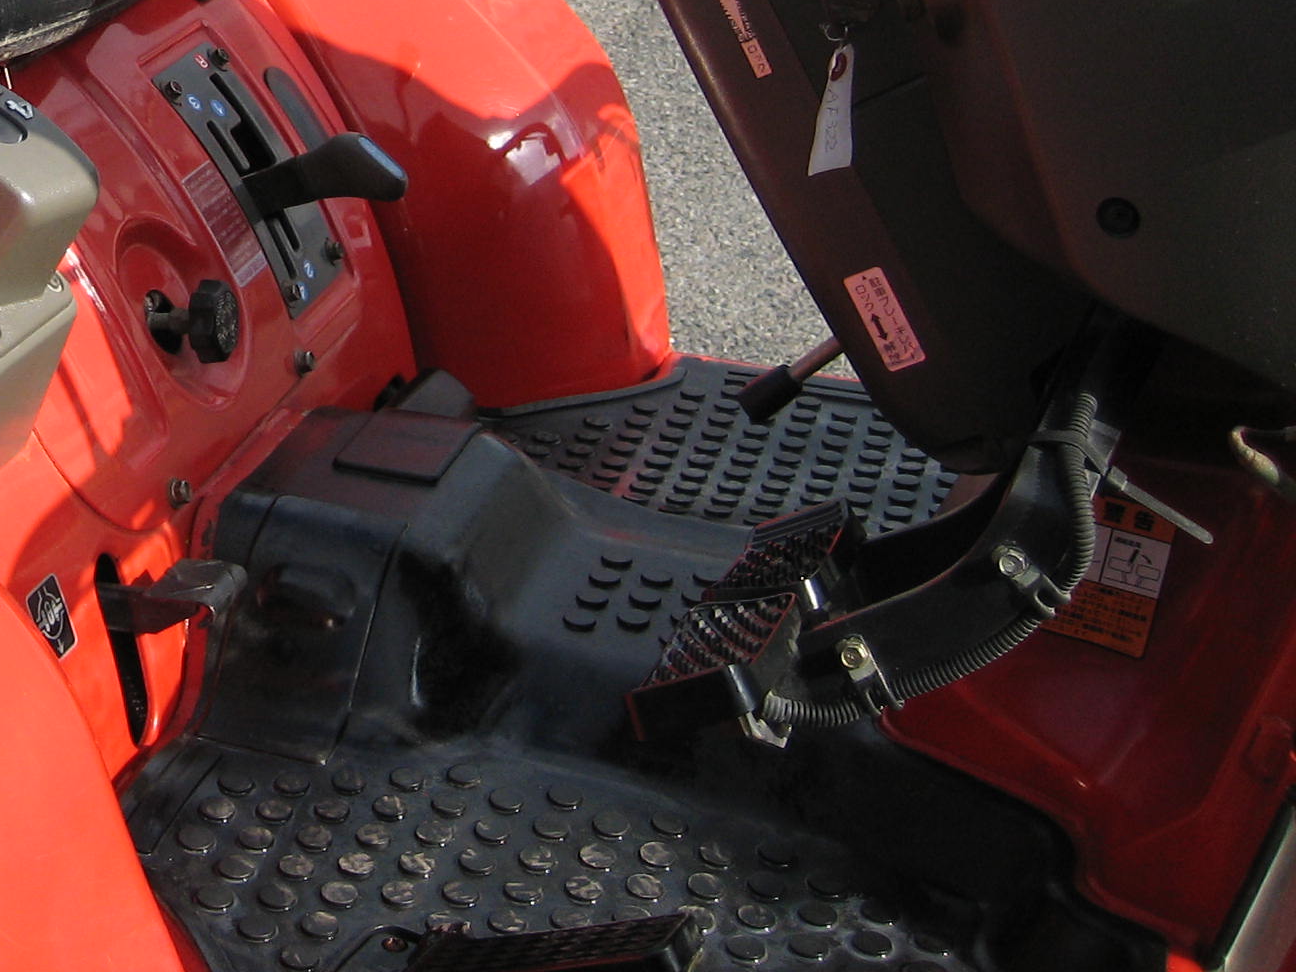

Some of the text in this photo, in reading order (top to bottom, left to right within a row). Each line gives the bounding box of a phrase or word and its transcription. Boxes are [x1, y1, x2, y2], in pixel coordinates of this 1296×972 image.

[6, 100, 34, 119] 4
[855, 283, 876, 314] ロック
